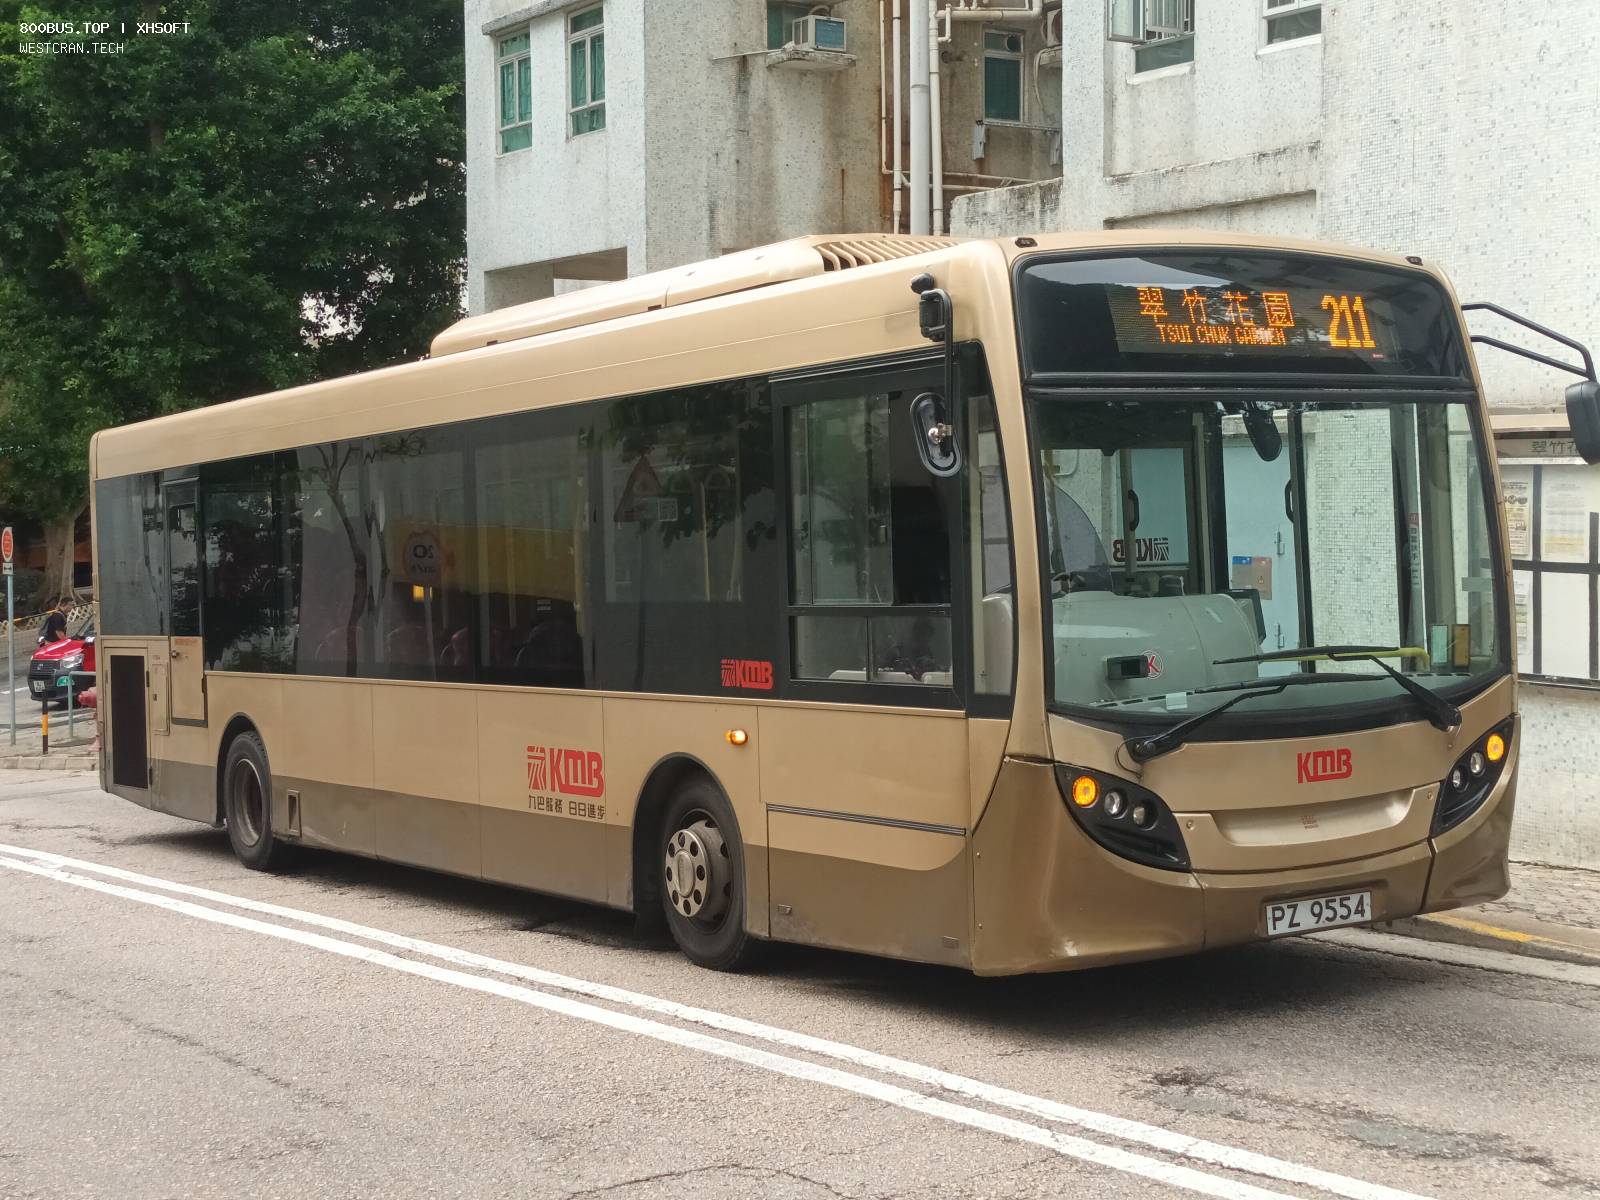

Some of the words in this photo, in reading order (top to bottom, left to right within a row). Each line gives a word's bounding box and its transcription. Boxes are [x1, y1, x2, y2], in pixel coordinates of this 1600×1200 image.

[1136, 287, 1295, 327] 翠竹花園
[1320, 294, 1377, 349] 211
[1155, 323, 1194, 343] TSUI
[1195, 325, 1232, 344] CHUK
[735, 659, 774, 690] KMB
[549, 747, 605, 798] KMB
[1296, 747, 1353, 785] KMB
[568, 800, 607, 820] 日日進步
[1271, 903, 1301, 931] PZ
[1310, 894, 1366, 925] 9554
